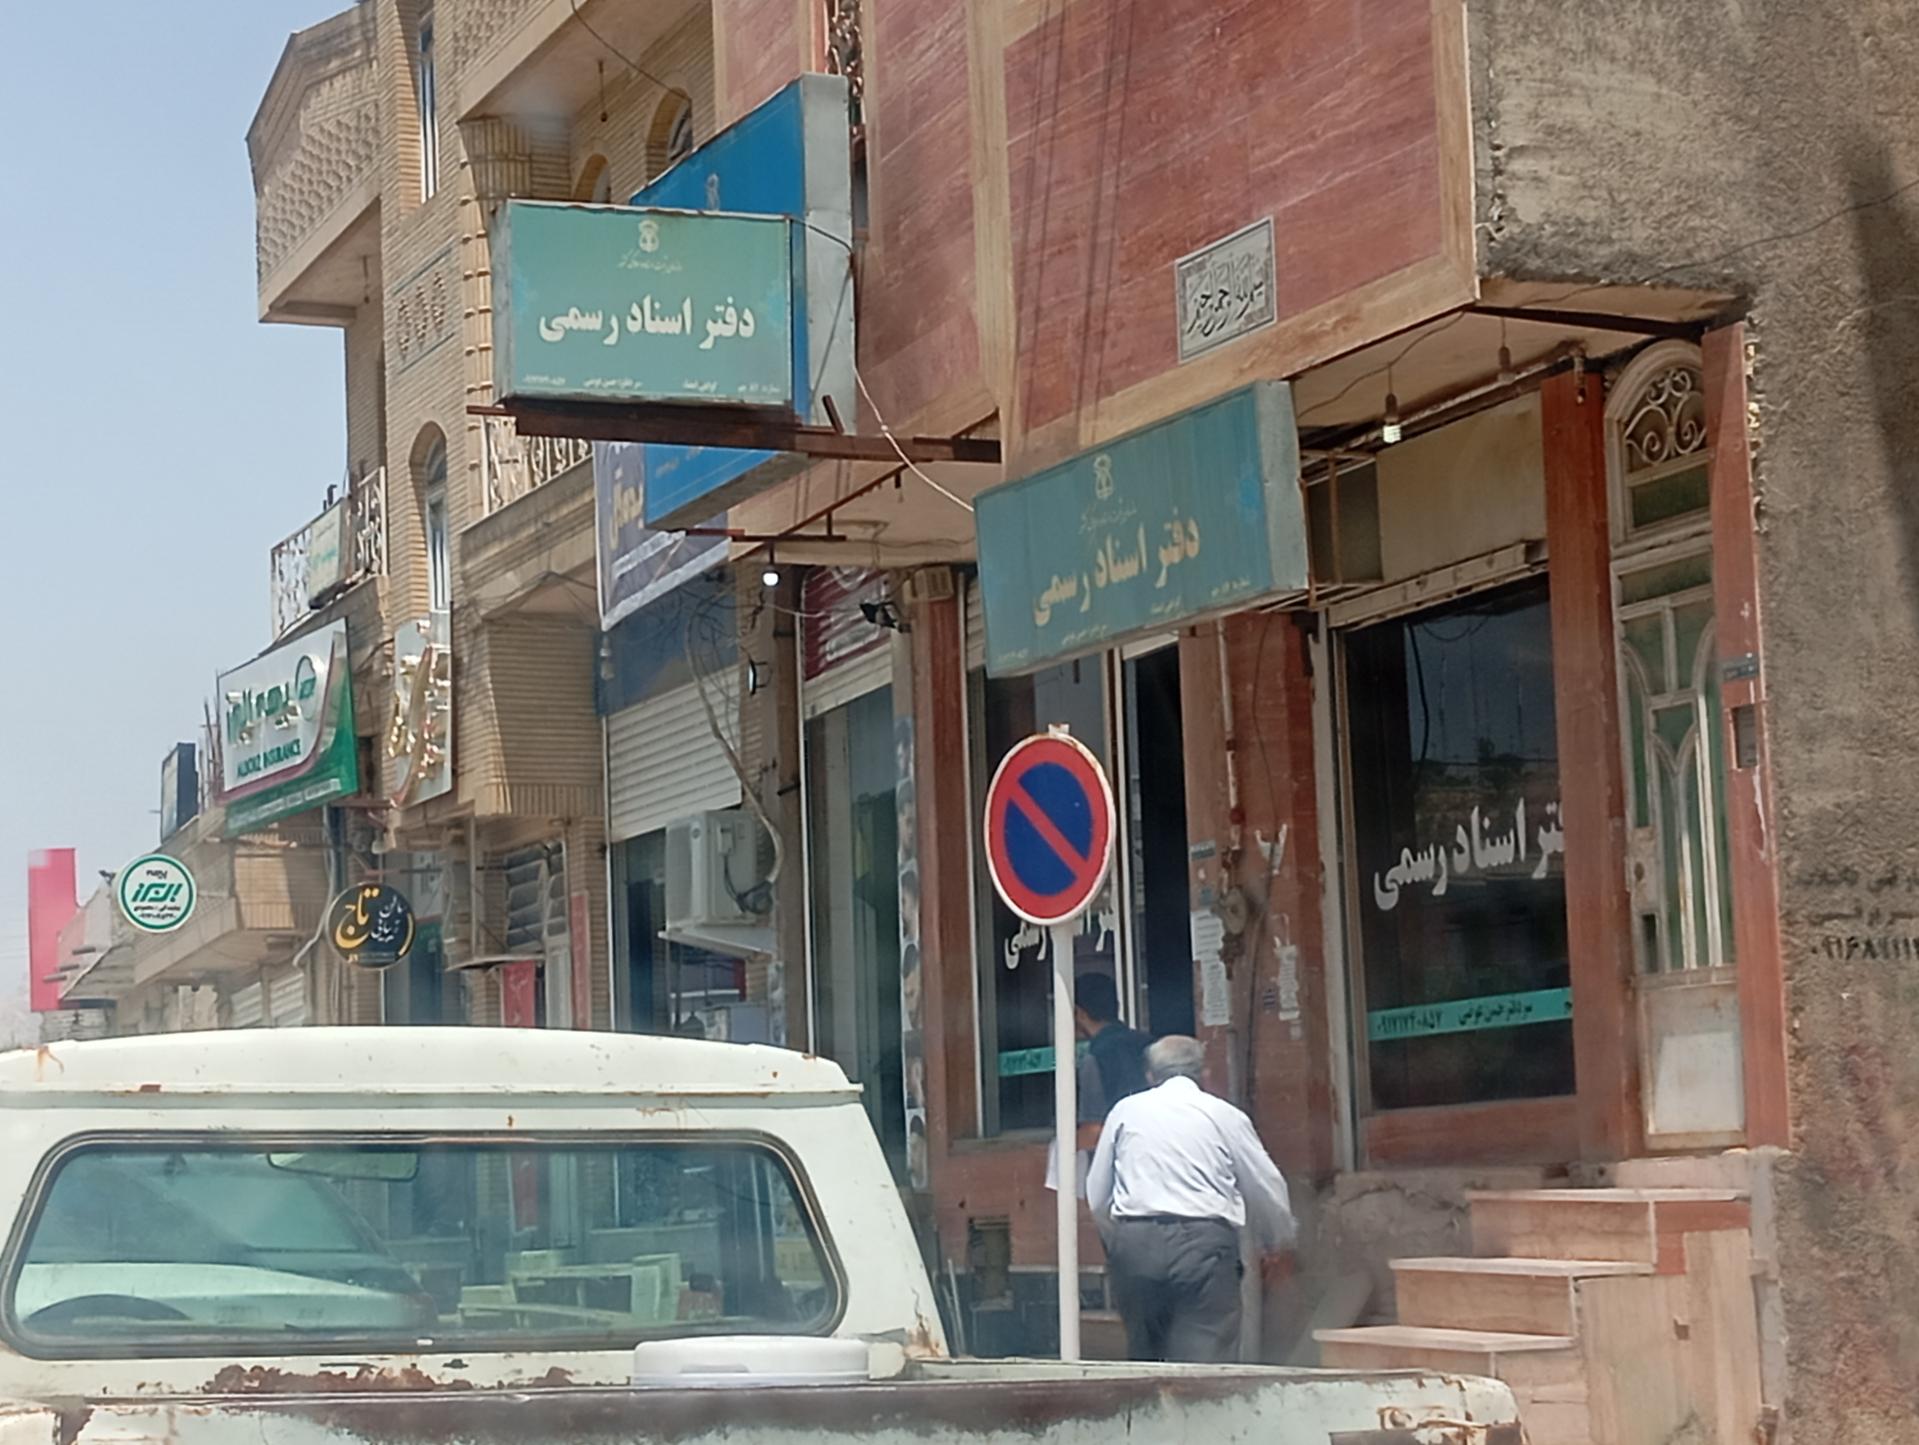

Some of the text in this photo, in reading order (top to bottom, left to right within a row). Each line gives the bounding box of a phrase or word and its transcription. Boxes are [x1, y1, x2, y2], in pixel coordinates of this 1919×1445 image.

[539, 294, 756, 350] دفتر اسناد رسمی
[1094, 519, 1147, 589] اسناد
[1156, 505, 1201, 589] دفتر
[1033, 570, 1092, 627] رسمی
[1374, 797, 1566, 911] تر اسناد رسمی
[335, 888, 381, 949] تاج
